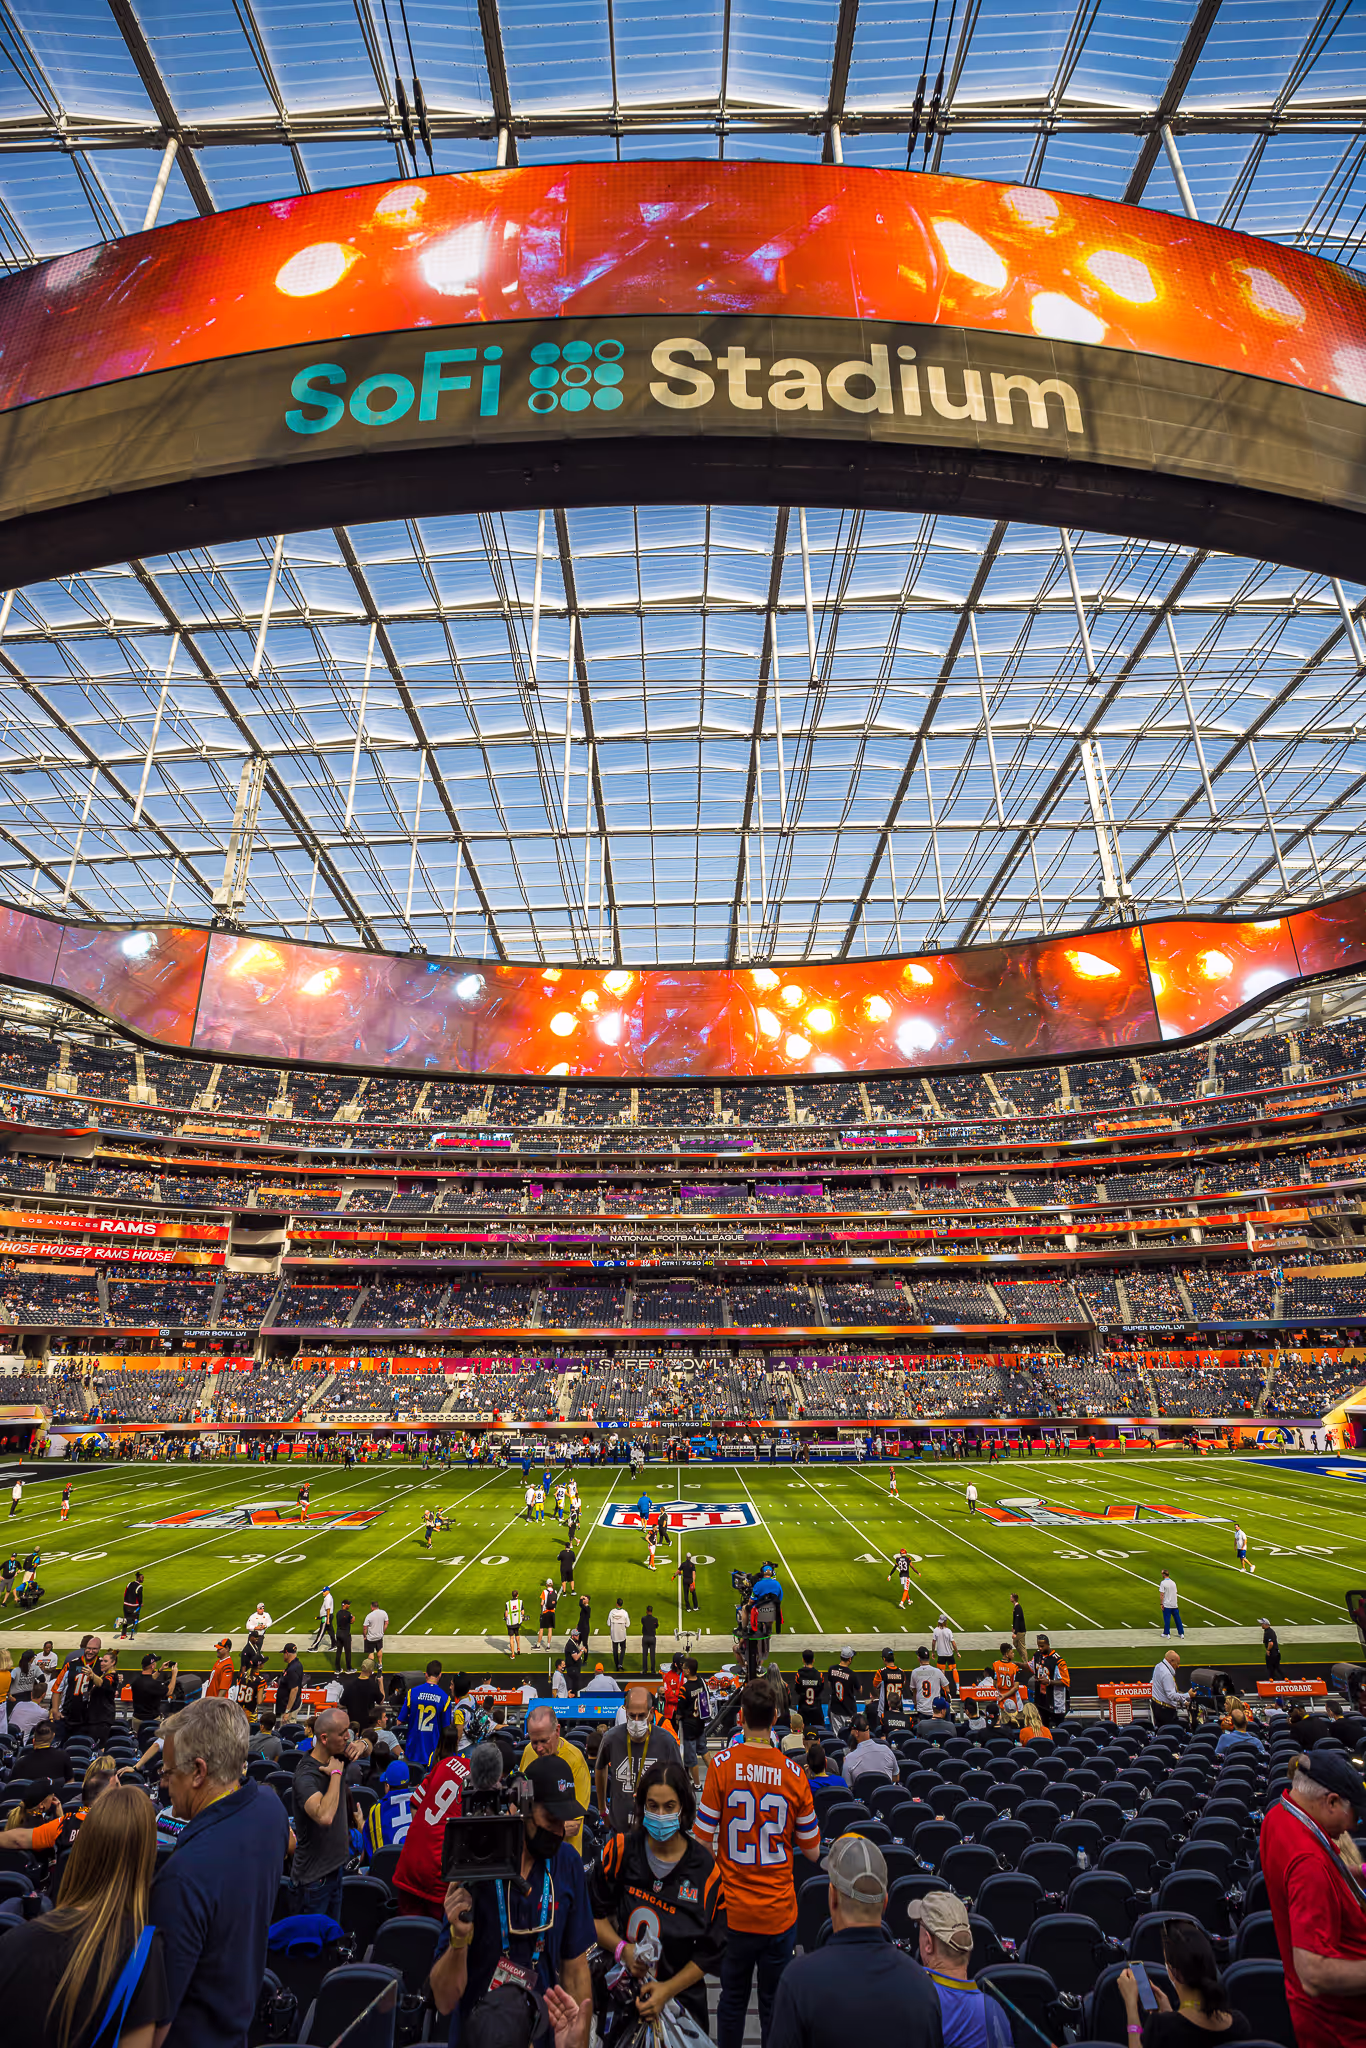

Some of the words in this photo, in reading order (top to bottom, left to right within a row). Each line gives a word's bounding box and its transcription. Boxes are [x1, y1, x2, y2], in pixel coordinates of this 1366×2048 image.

[285, 346, 503, 434] SoFi
[649, 337, 1083, 434] Stadium
[47, 1219, 98, 1228] ANGELES
[99, 1220, 157, 1235] RAMS
[40, 1245, 92, 1257] HOUSE?
[94, 1249, 130, 1260] RAMS
[132, 1251, 176, 1263] HOUSE!
[617, 1512, 742, 1528] NFL
[920, 1680, 932, 1698] 9
[999, 1673, 1012, 1688] 76
[1275, 1684, 1313, 1693] GATORADE
[237, 1683, 254, 1703] 58
[417, 1692, 442, 1704] JEFFERSON
[805, 1687, 815, 1706] 9
[834, 1681, 844, 1702] 9
[1114, 1688, 1151, 1696] GATORADE
[417, 1704, 437, 1732] 12
[887, 1719, 906, 1727] BURROW
[713, 1750, 731, 1768] 2
[785, 1758, 801, 1777] 2
[735, 1762, 782, 1787] E.SMITH
[424, 1779, 459, 1826] 9
[727, 1788, 788, 1866] 22
[628, 1886, 677, 1915] BENGALS
[679, 1885, 698, 1900] LVI
[499, 1961, 526, 1978] GAMEDAY
